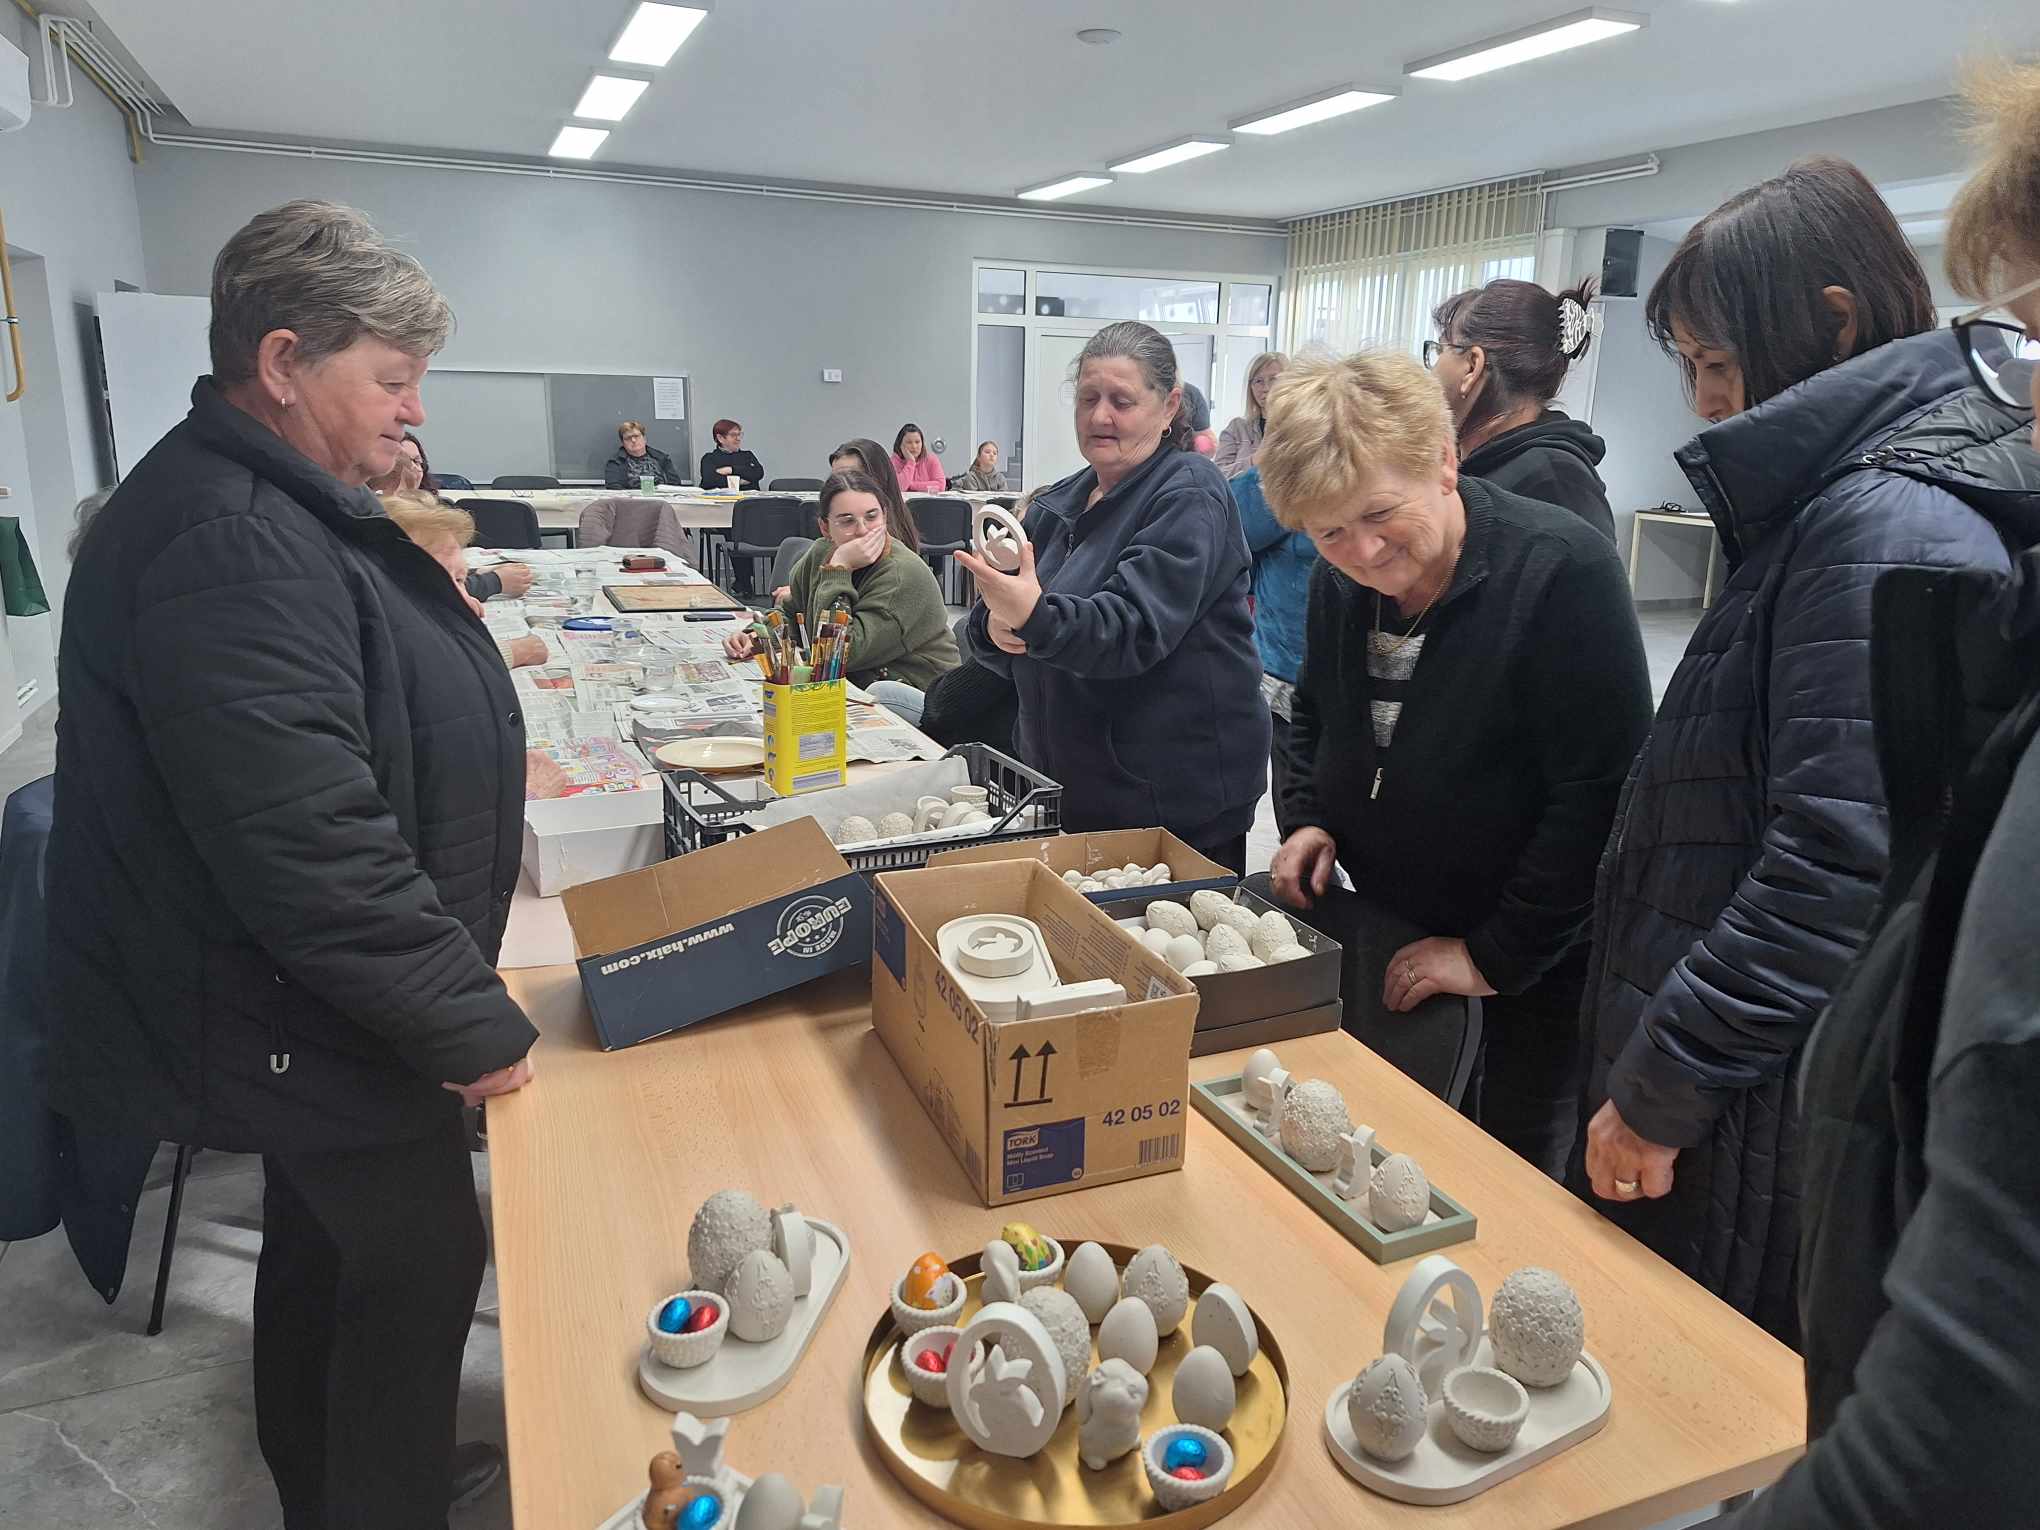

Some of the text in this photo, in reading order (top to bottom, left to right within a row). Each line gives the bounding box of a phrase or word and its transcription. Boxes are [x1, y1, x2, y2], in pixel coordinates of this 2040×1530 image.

[601, 923, 734, 975] www.haix.com
[767, 896, 852, 956] EUROPE
[950, 986, 962, 1021] 05
[964, 1006, 978, 1045] 02
[1102, 1099, 1181, 1127] 42 05 02
[1009, 1135, 1036, 1147] TORK
